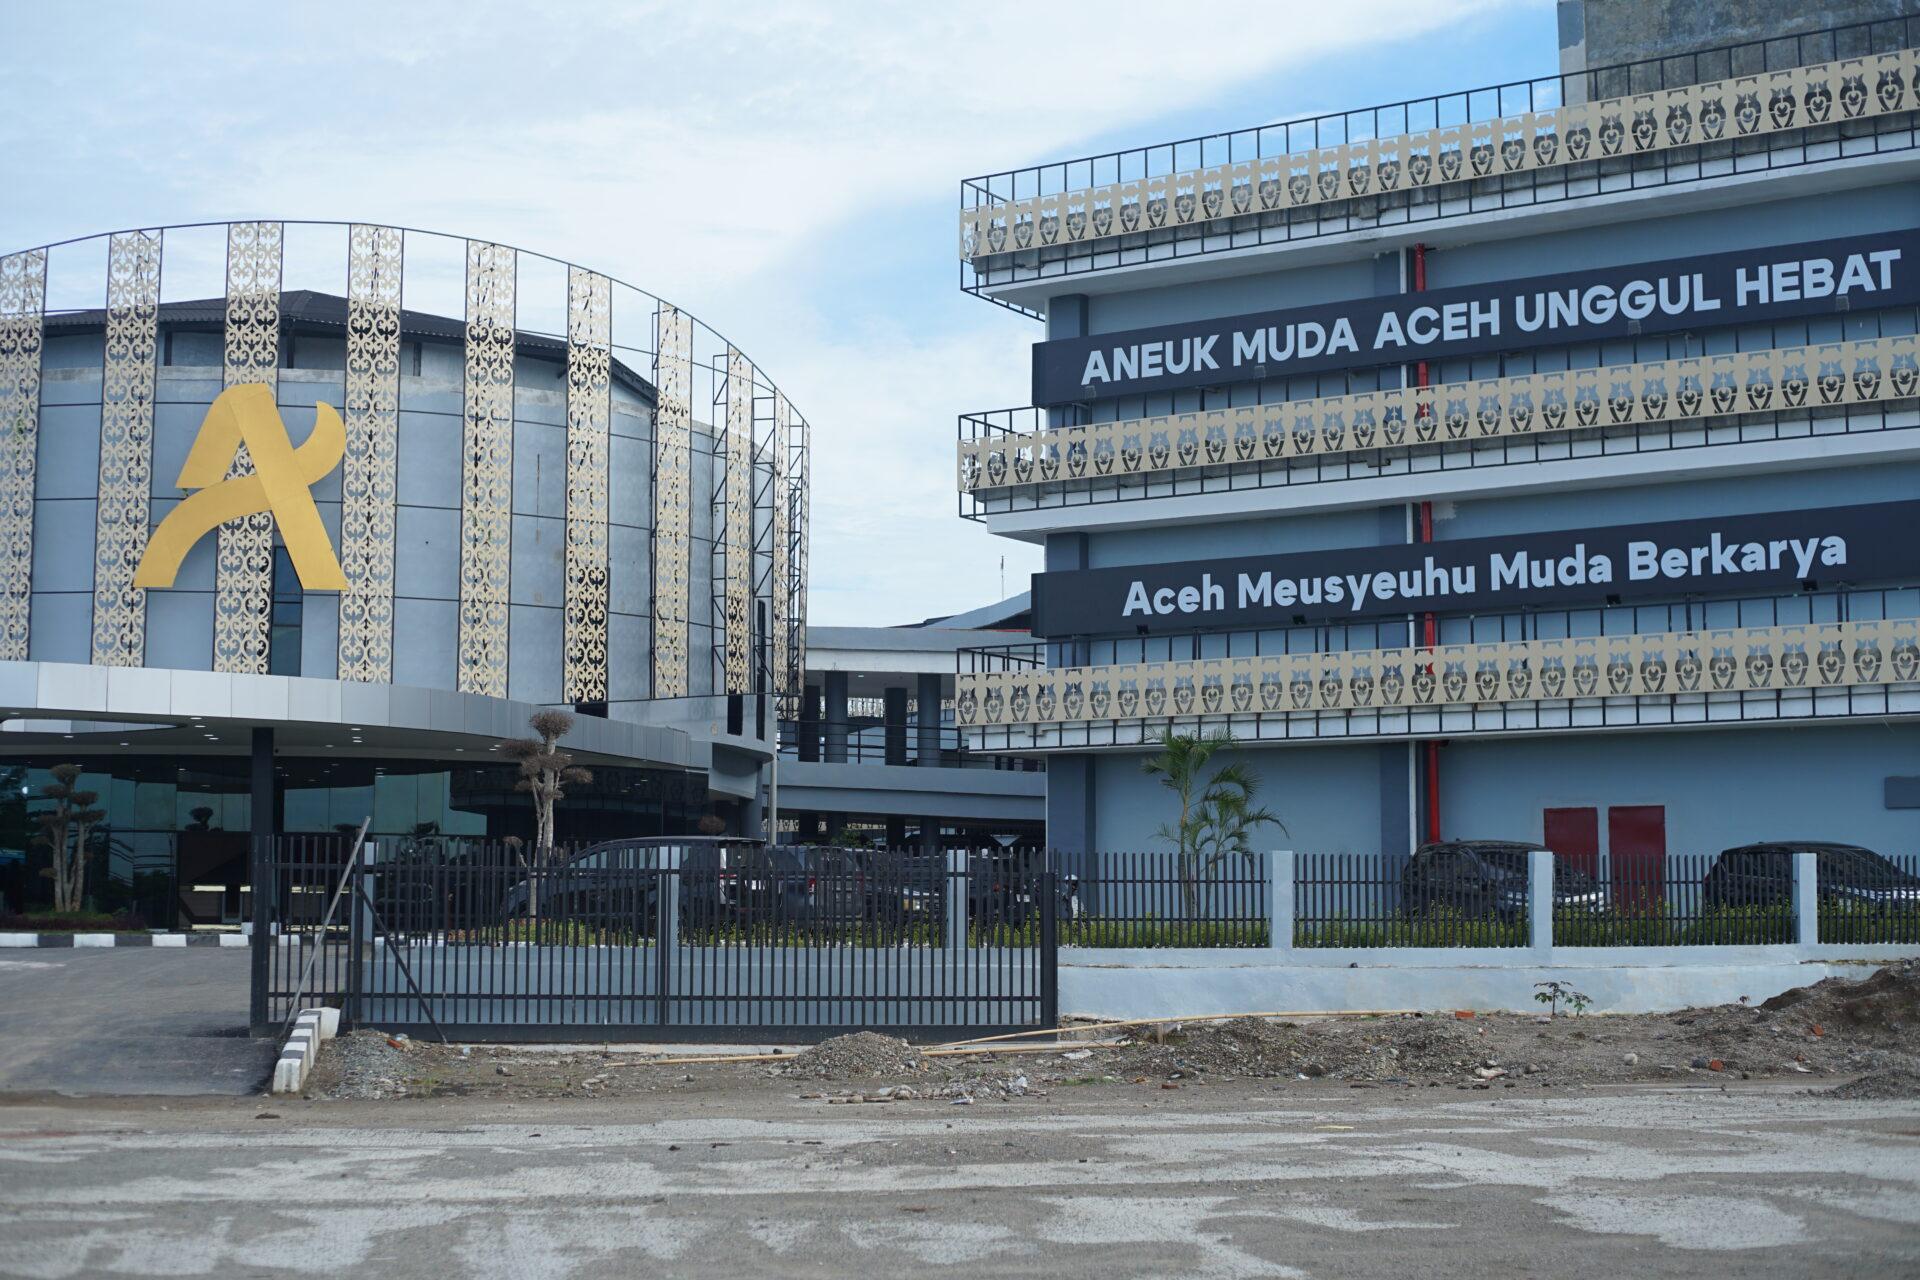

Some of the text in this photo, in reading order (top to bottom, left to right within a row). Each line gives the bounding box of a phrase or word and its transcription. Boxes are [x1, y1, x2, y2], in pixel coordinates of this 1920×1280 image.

[1081, 249, 1902, 386] ANEUK MUDA ACEH UNGGUL HEBAT
[1122, 532, 1847, 617] Aceh Meusyeuhu Muda Berkarya
